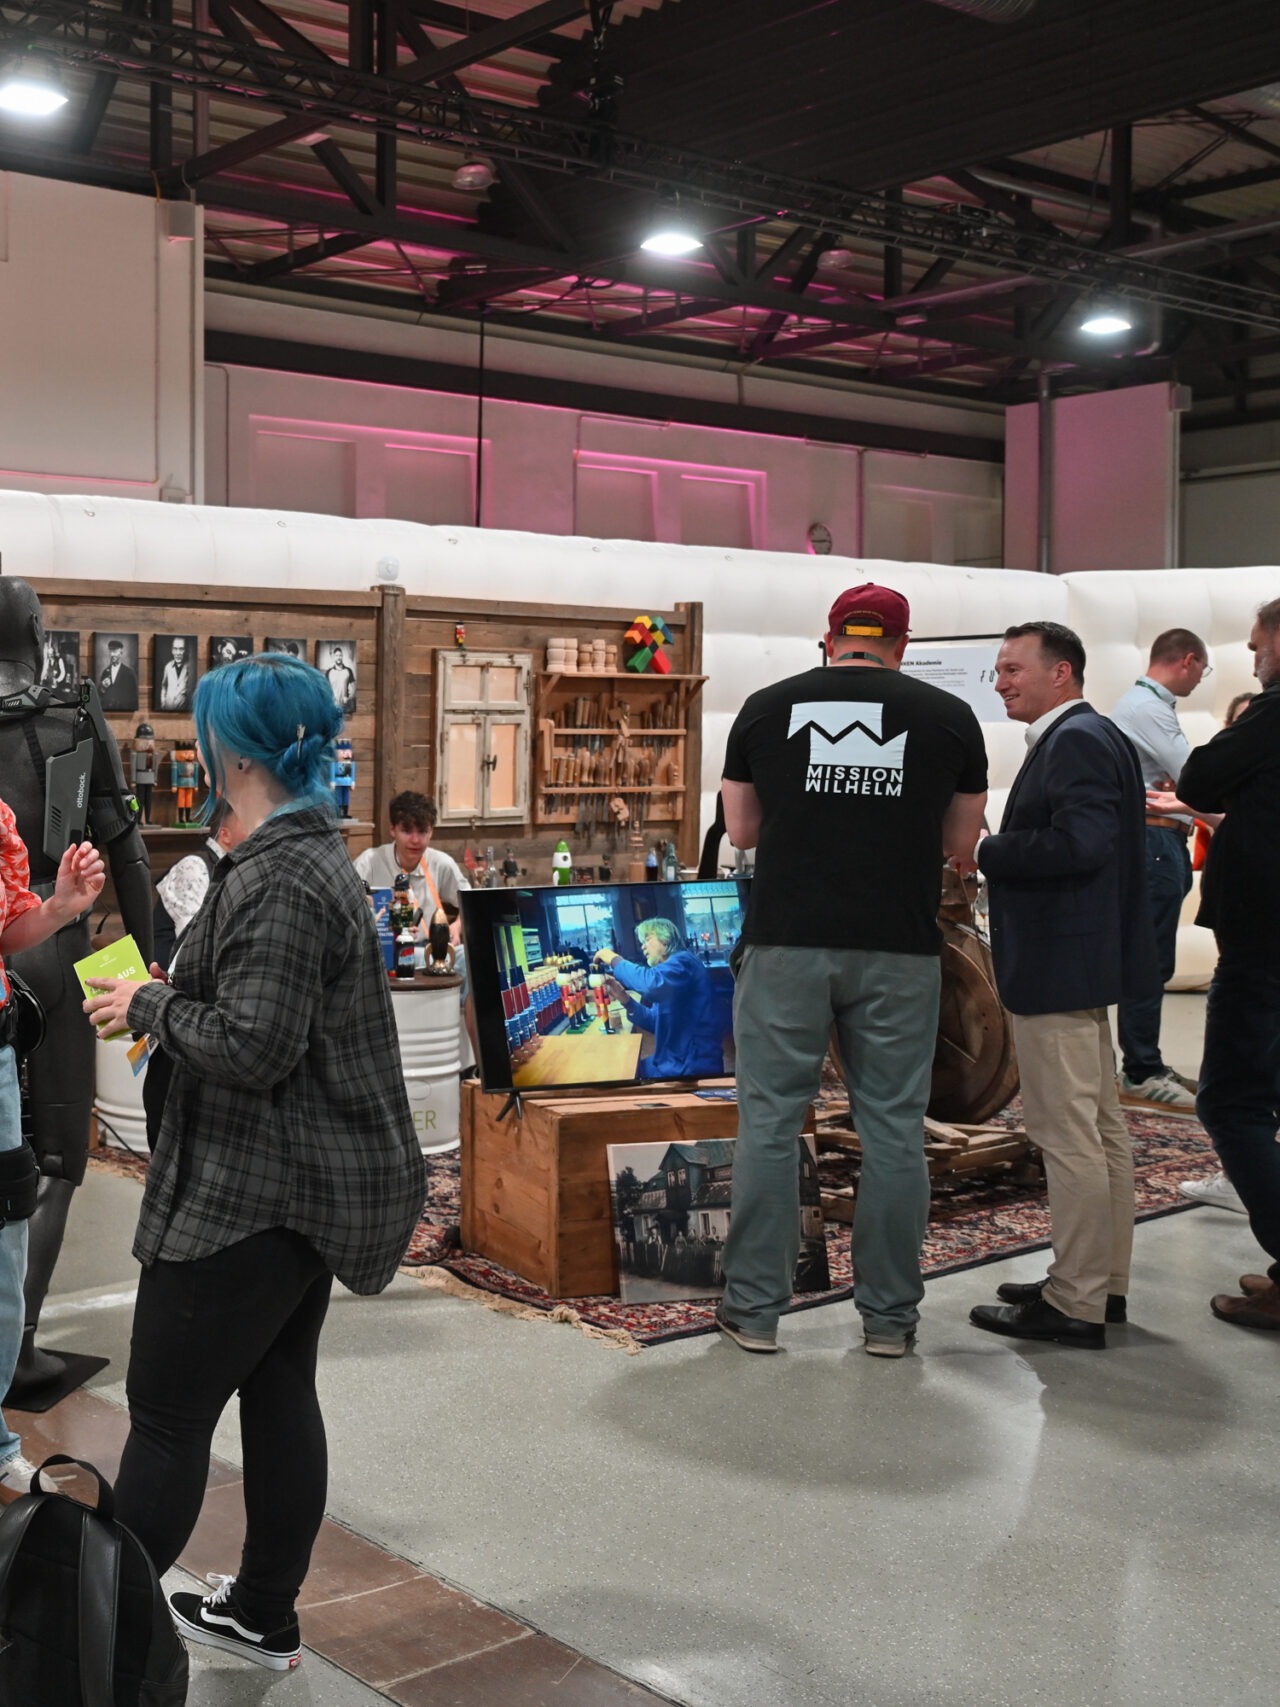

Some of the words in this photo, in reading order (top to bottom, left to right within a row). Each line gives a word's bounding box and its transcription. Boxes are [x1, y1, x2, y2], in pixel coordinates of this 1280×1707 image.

[807, 765, 904, 782] MISSION
[76, 772, 86, 808] ottobock.
[805, 779, 902, 796] WILHELM
[412, 1110, 437, 1131] ER
